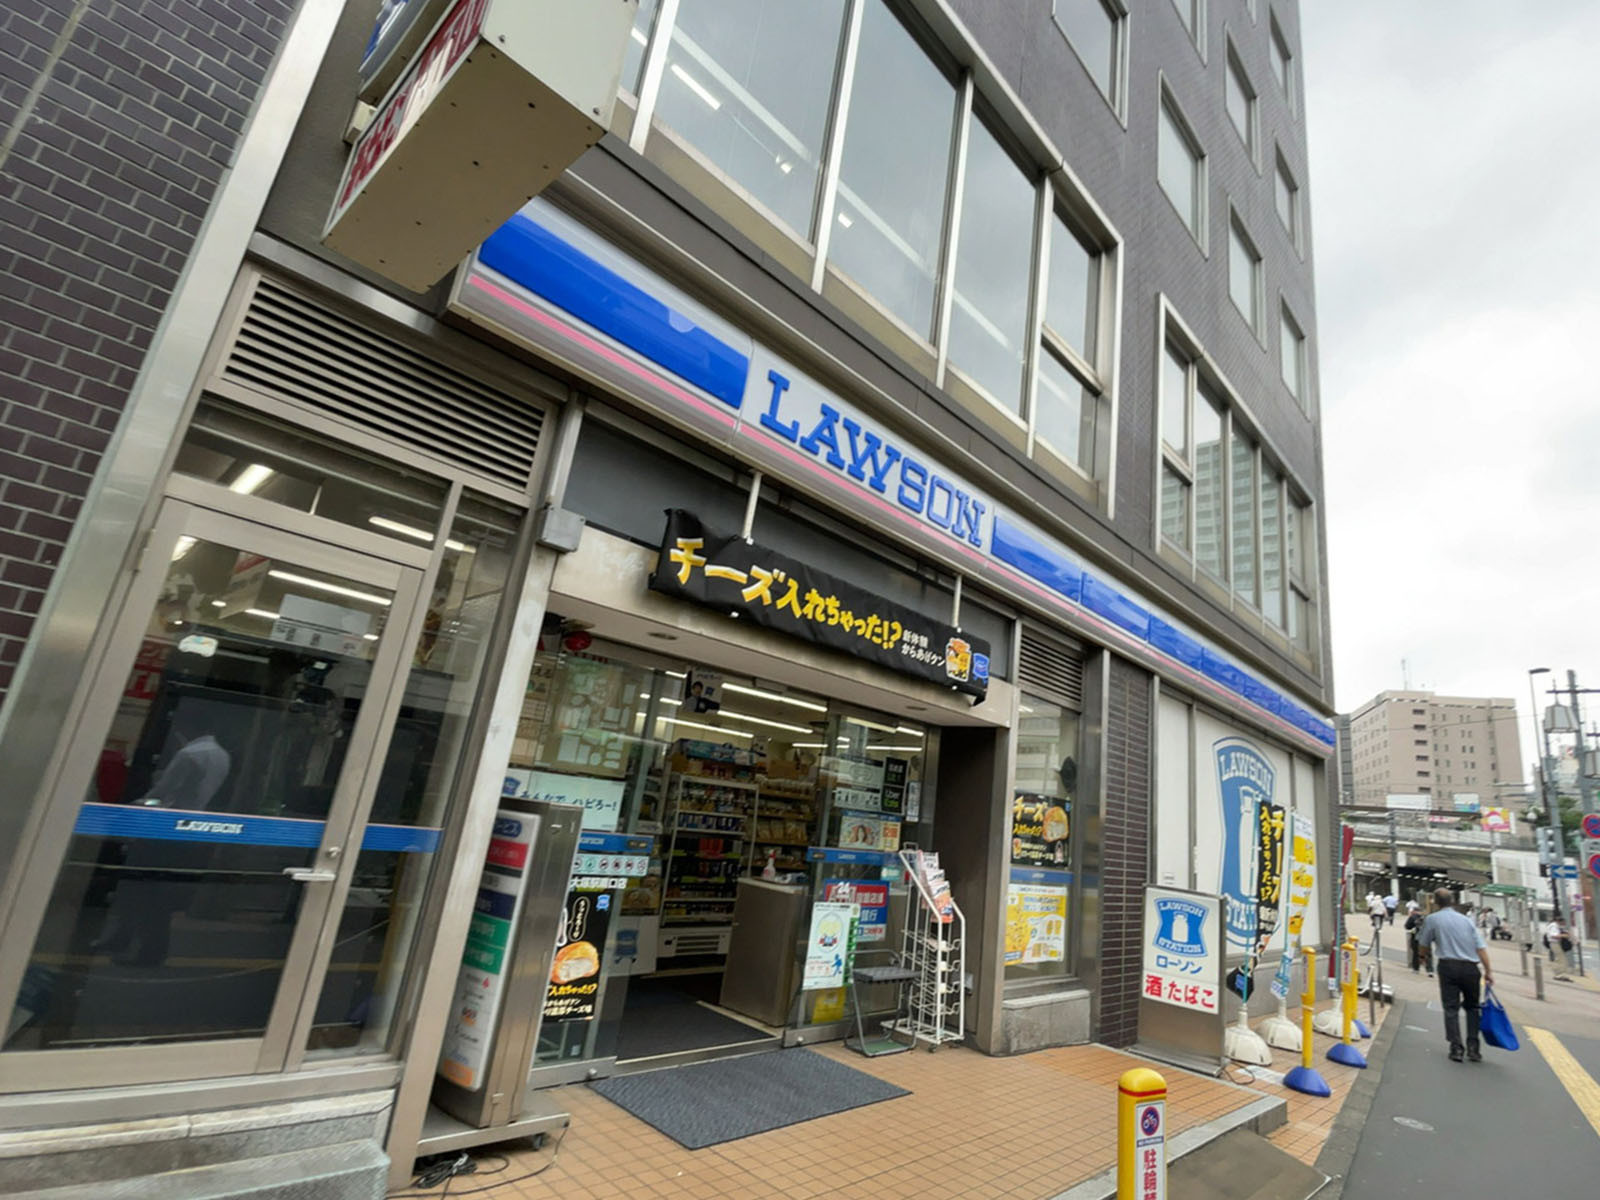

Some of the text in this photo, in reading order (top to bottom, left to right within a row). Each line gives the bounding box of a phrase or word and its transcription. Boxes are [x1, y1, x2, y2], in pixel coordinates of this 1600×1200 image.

[760, 369, 985, 548] LAWSON
[1219, 751, 1274, 796] LAWSON
[1159, 901, 1204, 917] LAWSON
[1158, 937, 1203, 954] STATION
[1156, 955, 1203, 974] ローソン
